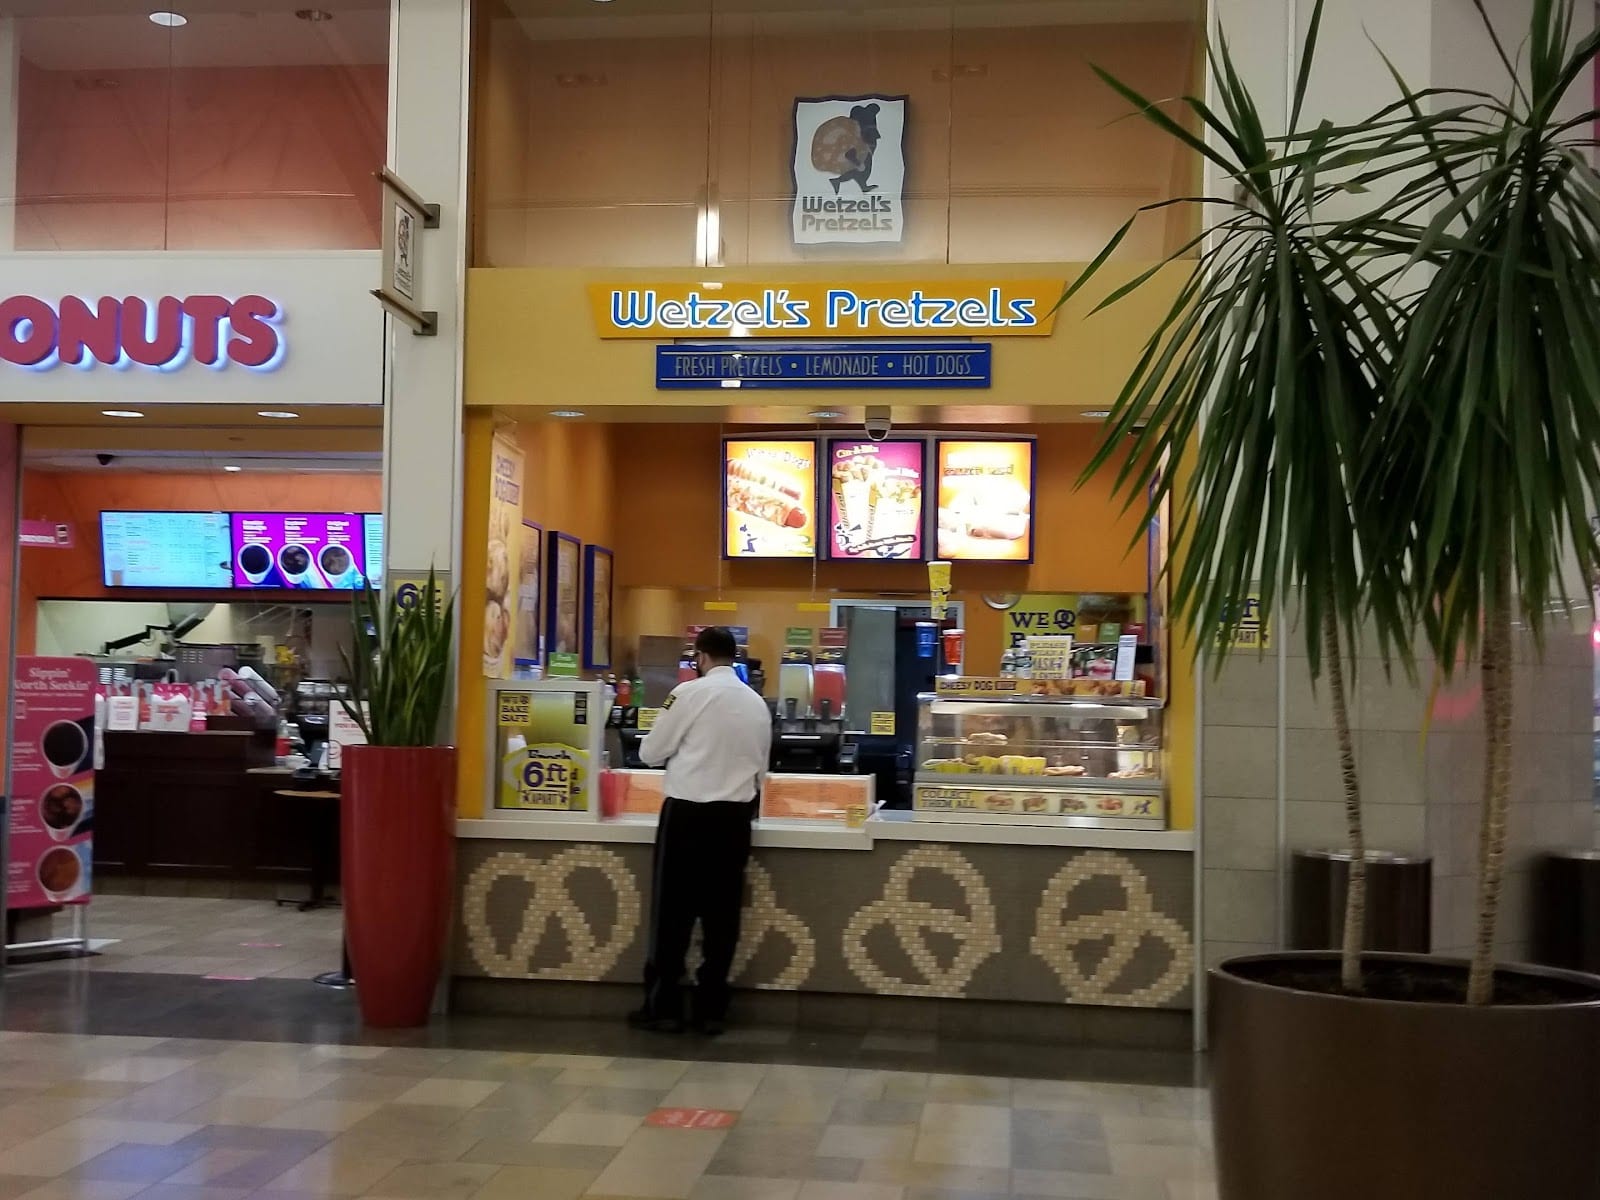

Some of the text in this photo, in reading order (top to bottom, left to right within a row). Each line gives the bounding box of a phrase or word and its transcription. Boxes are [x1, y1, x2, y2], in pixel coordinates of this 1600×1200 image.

[802, 196, 892, 213] Wetzel's
[802, 214, 893, 231] Pretzels
[610, 288, 1037, 329] Wetzel's Pretzels
[0, 295, 284, 370] ONUTS
[675, 355, 971, 376] FRESH PRETZELS LEMONADE HOT DOGS
[1009, 612, 1049, 629] WE
[523, 761, 568, 787] 6ft
